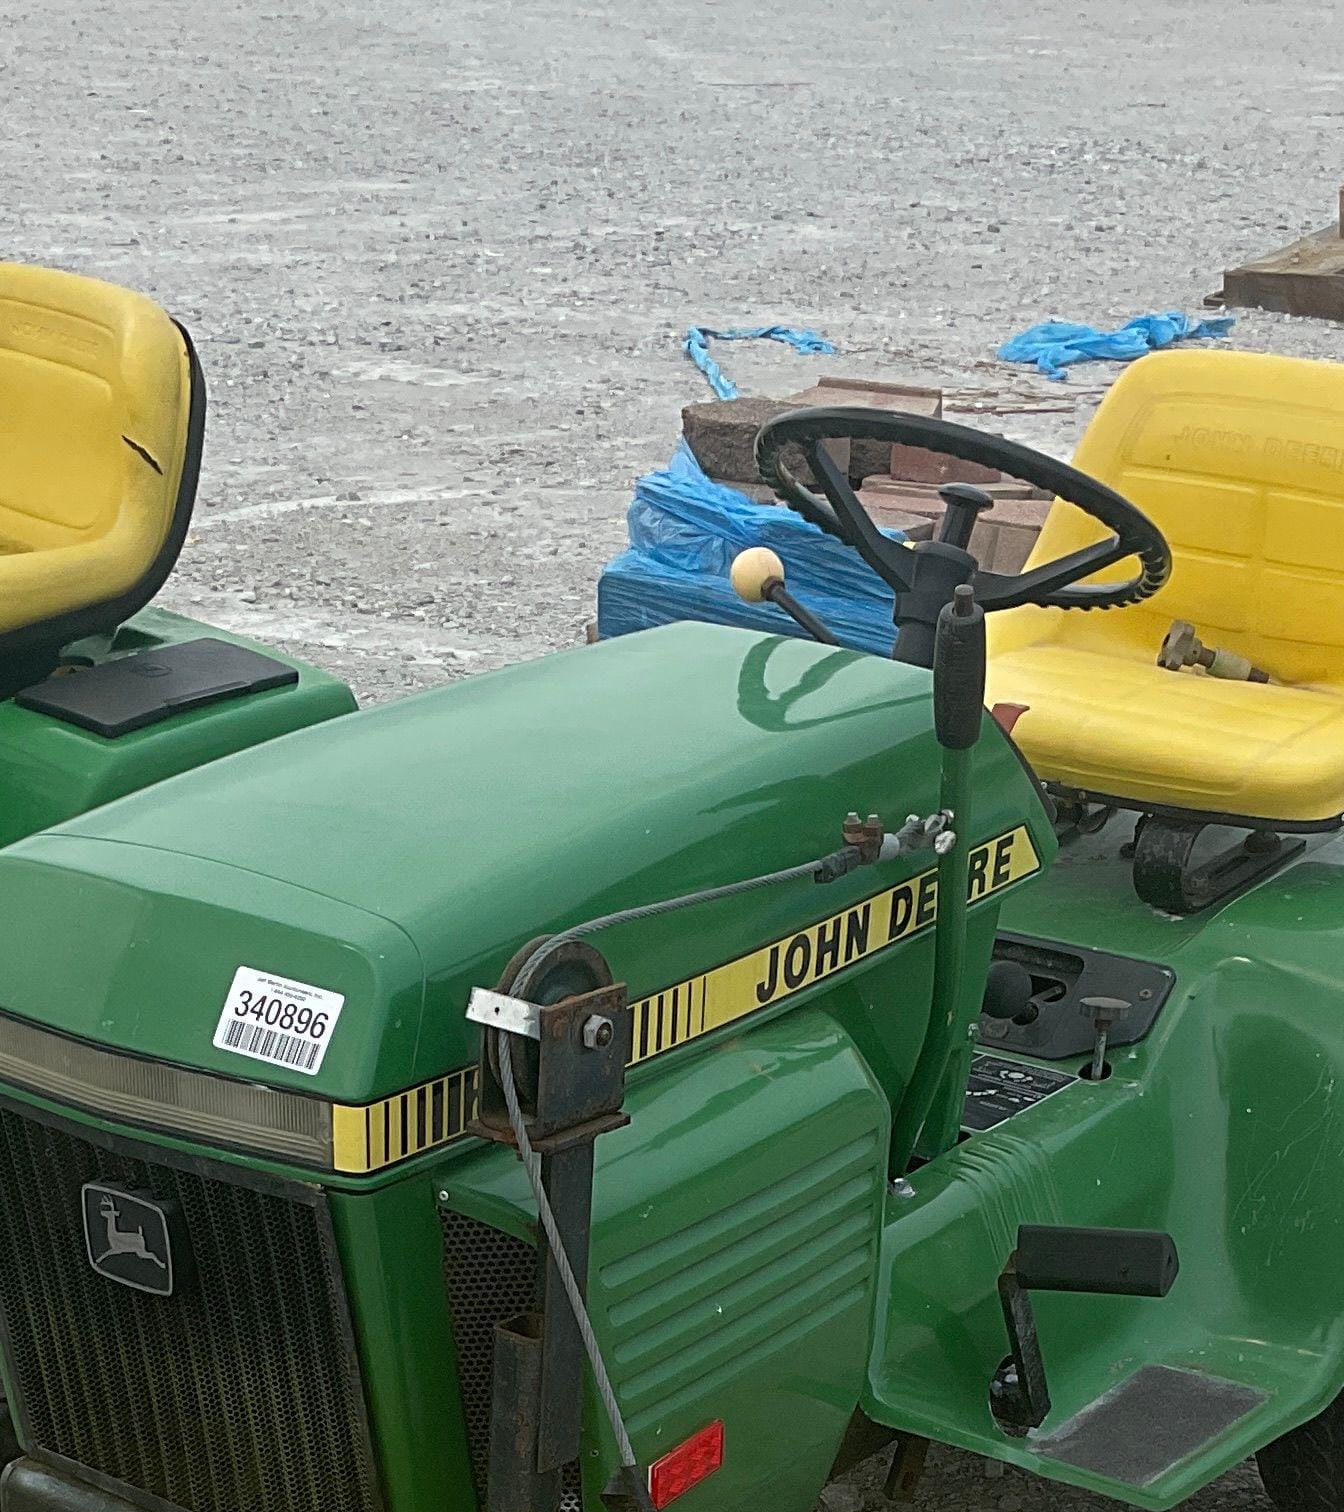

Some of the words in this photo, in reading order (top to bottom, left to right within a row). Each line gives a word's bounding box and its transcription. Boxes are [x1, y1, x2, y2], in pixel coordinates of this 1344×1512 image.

[755, 903, 872, 1004] JOHN
[888, 833, 1015, 942] DERE
[234, 990, 329, 1039] 340896
